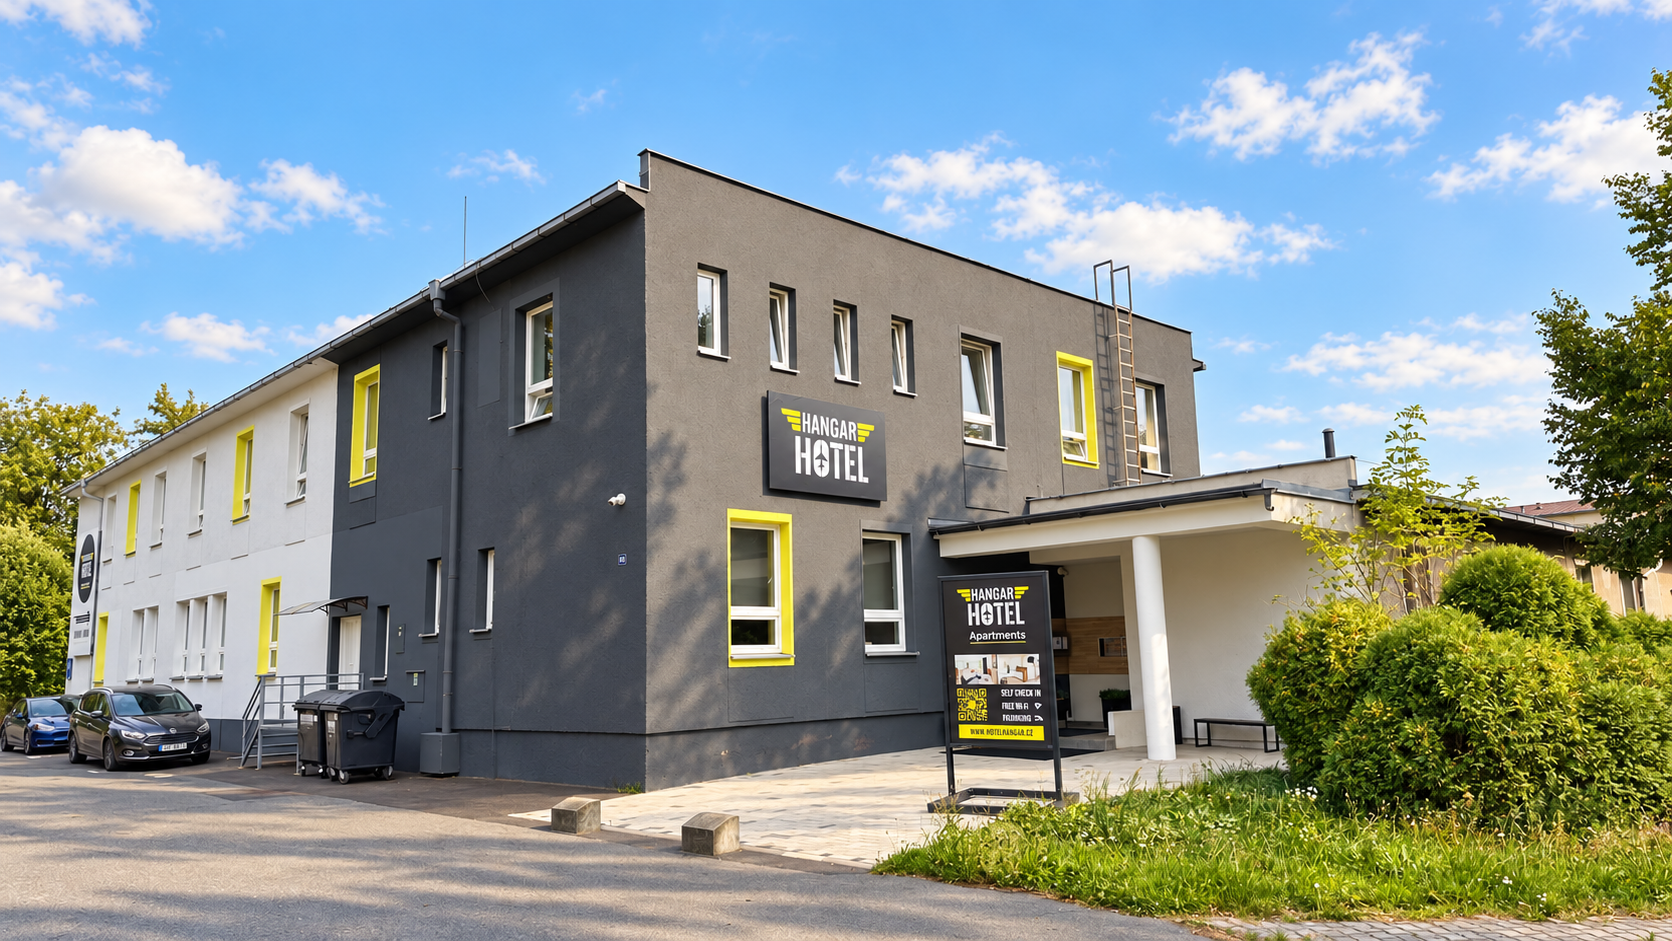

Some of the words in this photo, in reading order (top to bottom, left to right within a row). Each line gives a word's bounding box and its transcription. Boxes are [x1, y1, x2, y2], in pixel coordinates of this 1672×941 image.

[802, 412, 857, 442] HANGAR
[794, 435, 869, 484] HOTEL
[971, 587, 1014, 602] HANGAR
[967, 601, 1025, 626] HOTEL
[969, 631, 1026, 641] Apartments
